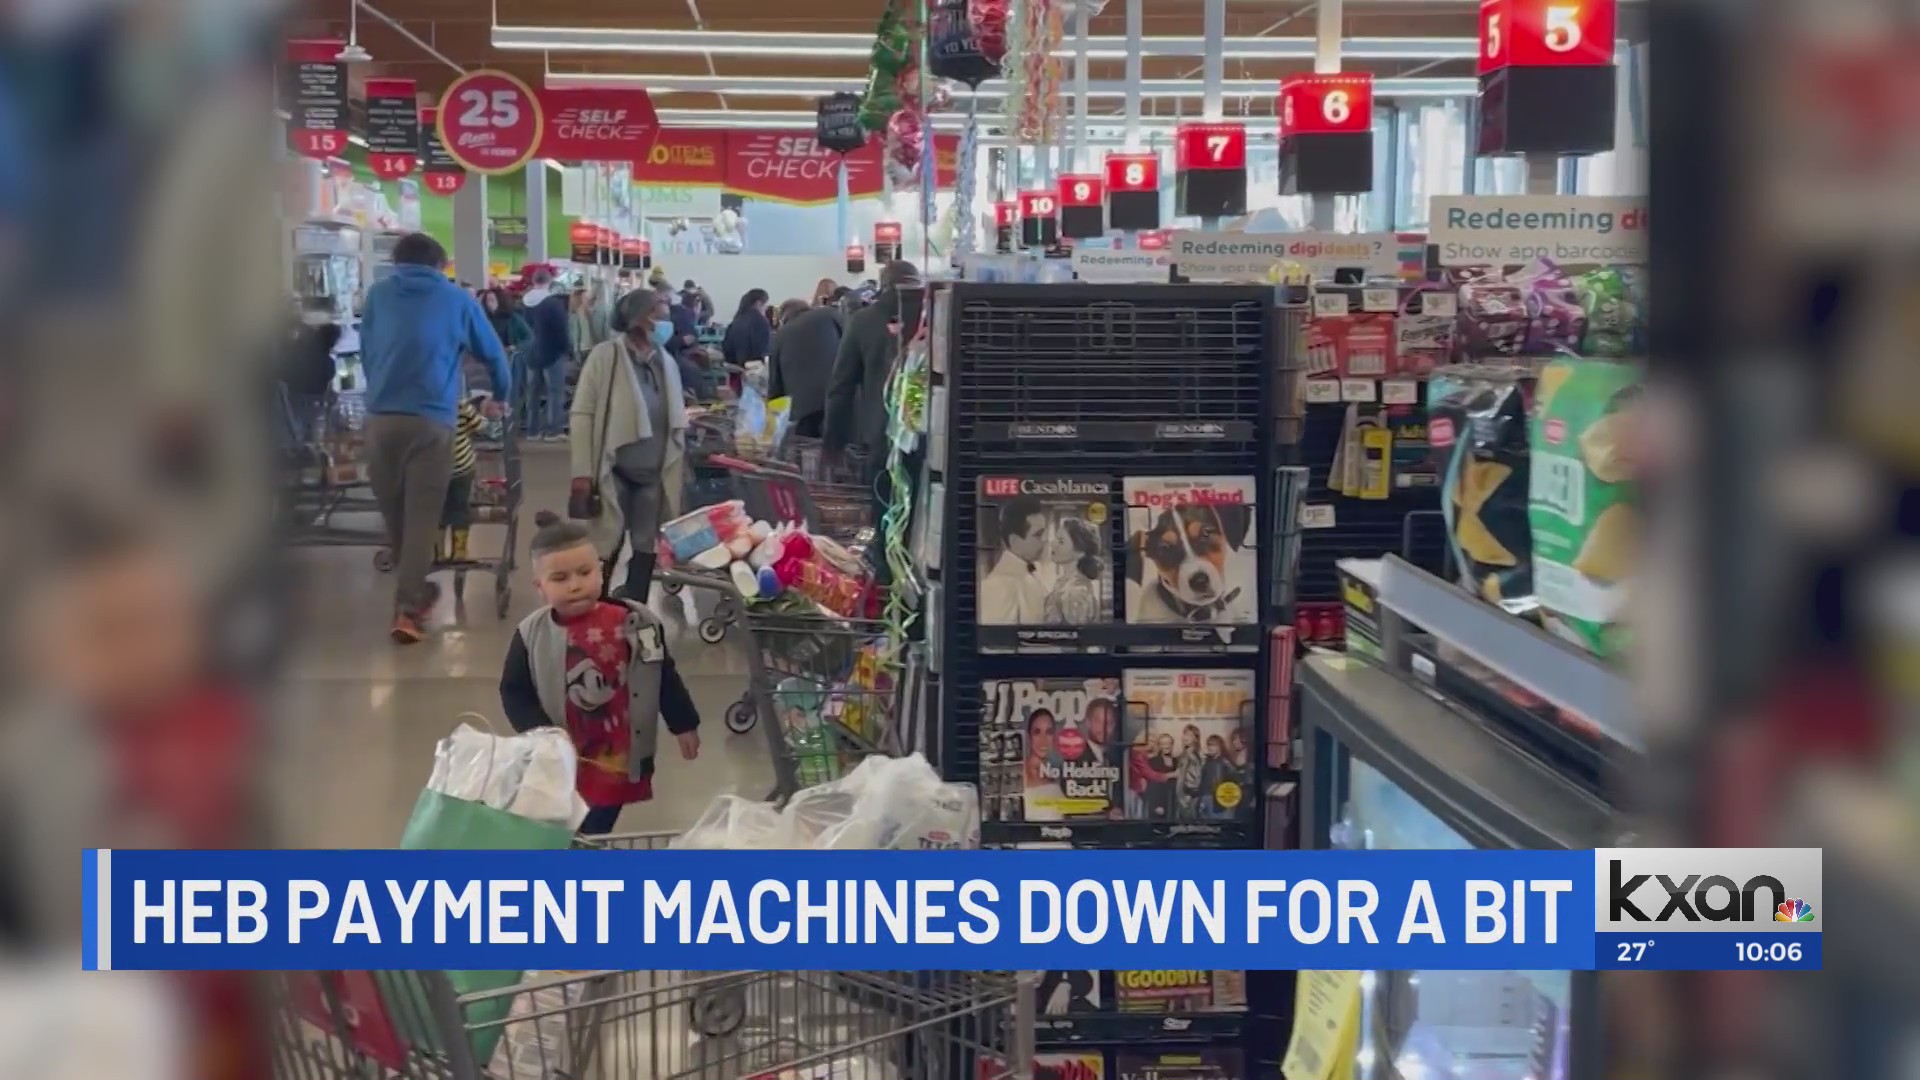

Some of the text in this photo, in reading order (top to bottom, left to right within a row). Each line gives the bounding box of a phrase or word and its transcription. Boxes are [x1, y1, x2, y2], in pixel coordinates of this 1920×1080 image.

[1487, 14, 1501, 59] 5
[1544, 5, 1582, 52] 5
[459, 89, 519, 127] 25
[1322, 90, 1350, 123] 6
[578, 109, 628, 124] SELF
[557, 124, 624, 140] CHECK
[310, 134, 337, 151] 15
[776, 136, 833, 157] SEL
[1207, 136, 1230, 162] 7
[384, 158, 406, 172] 14
[747, 158, 836, 179] CHECK
[1125, 163, 1145, 186] 8
[436, 176, 457, 189] 13
[1074, 182, 1090, 201] 9
[1030, 197, 1054, 214] 10
[1448, 207, 1613, 234] Redeeming
[1182, 241, 1285, 257] Redeeming
[1445, 243, 1500, 259] Show
[1080, 255, 1150, 266] Redeeming
[985, 479, 1109, 495] LIFE Casablanca
[1133, 488, 1244, 508] Dog's Mind
[1010, 679, 1119, 729] Peop
[1039, 761, 1120, 782] No Holding
[1066, 779, 1107, 797] Back!
